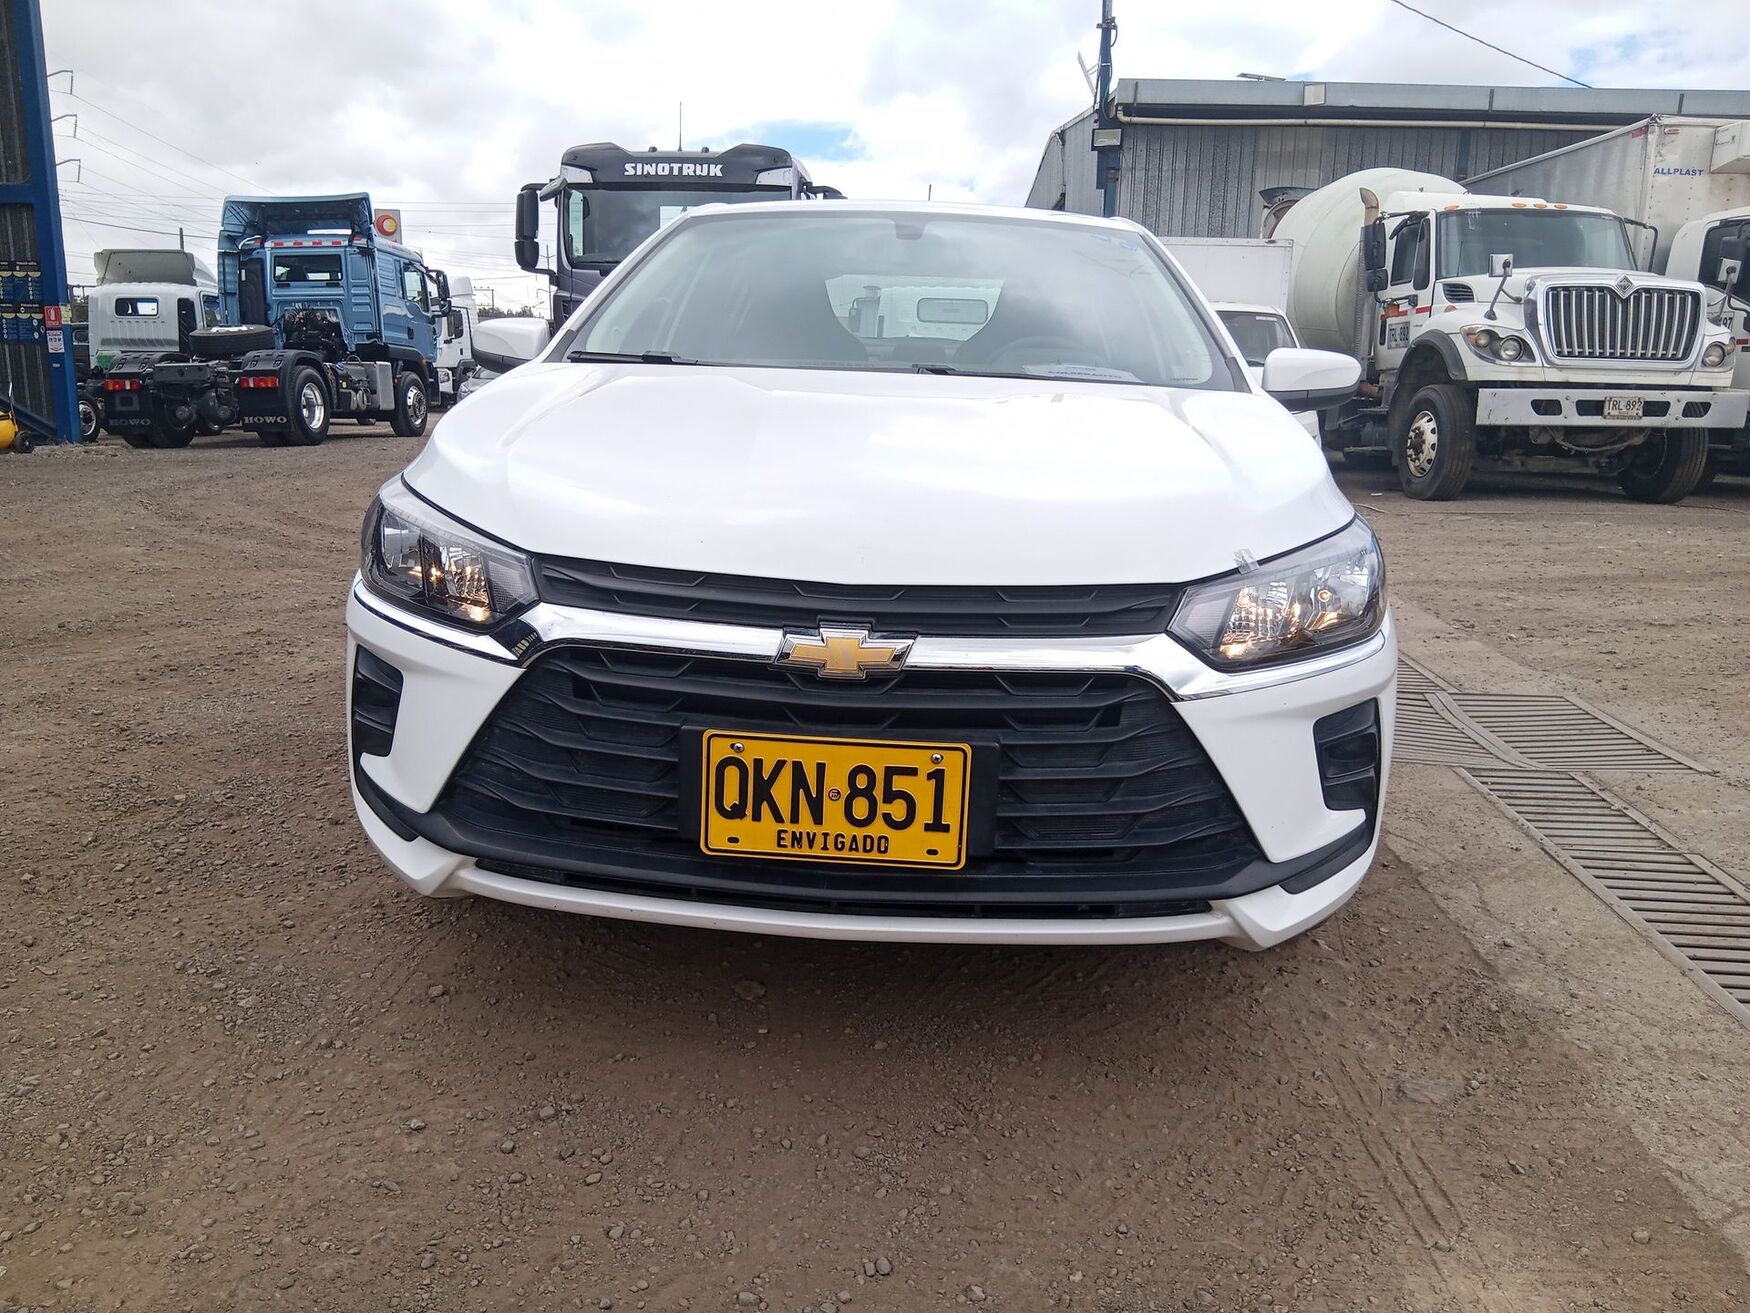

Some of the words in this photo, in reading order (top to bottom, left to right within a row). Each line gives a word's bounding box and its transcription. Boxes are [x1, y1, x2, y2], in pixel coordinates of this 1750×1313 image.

[624, 163, 723, 177] SINOTRUK
[1653, 168, 1704, 177] ALLPLAST
[243, 416, 288, 424] HOWO
[776, 829, 889, 854] ENVIGADO
